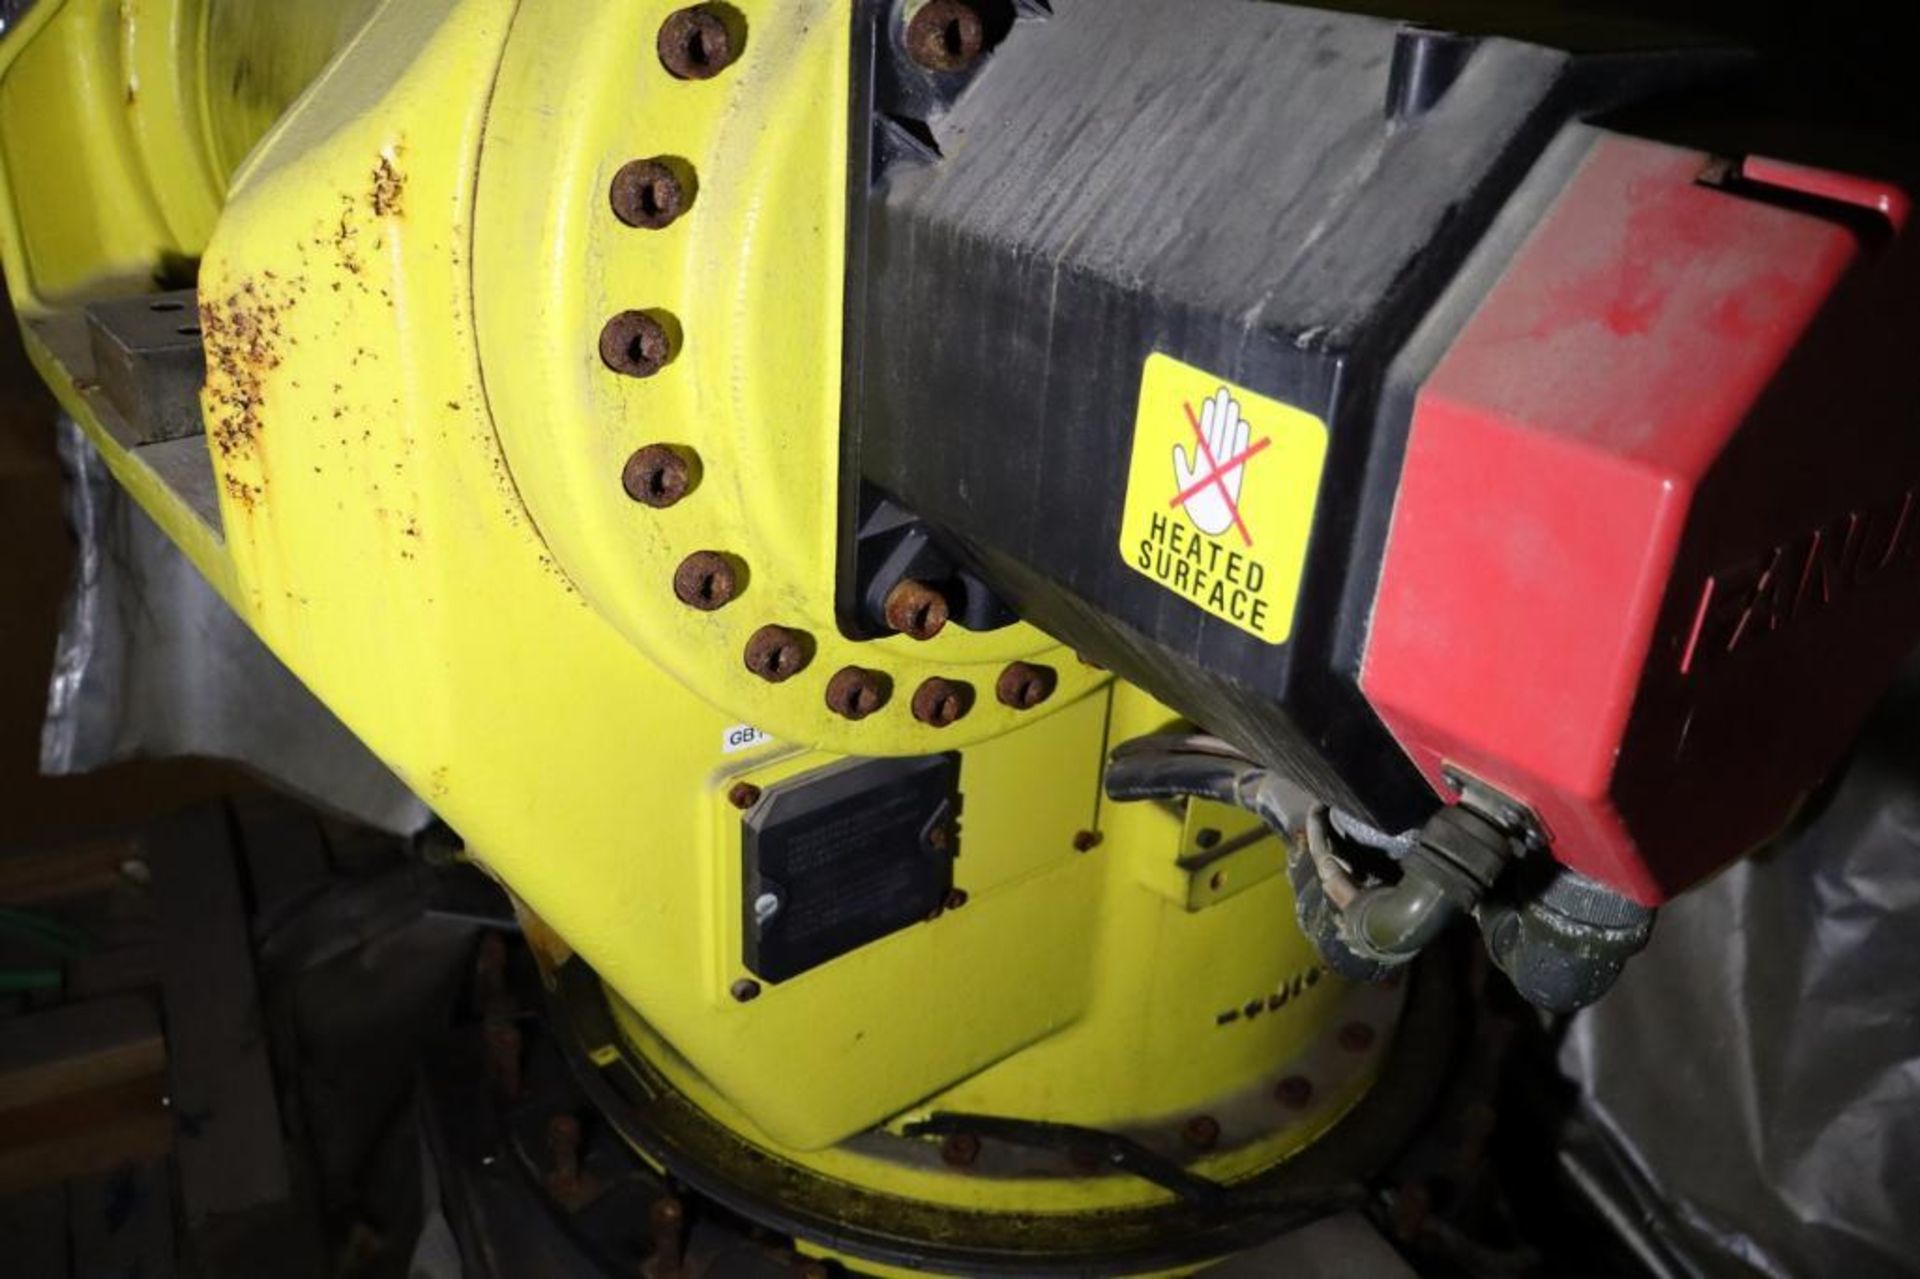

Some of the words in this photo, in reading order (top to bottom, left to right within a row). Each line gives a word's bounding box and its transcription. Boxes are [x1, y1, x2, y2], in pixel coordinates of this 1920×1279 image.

[1138, 539, 1269, 631] SURFACE
[1150, 512, 1264, 593] HEATED
[1679, 485, 1919, 674] FANU
